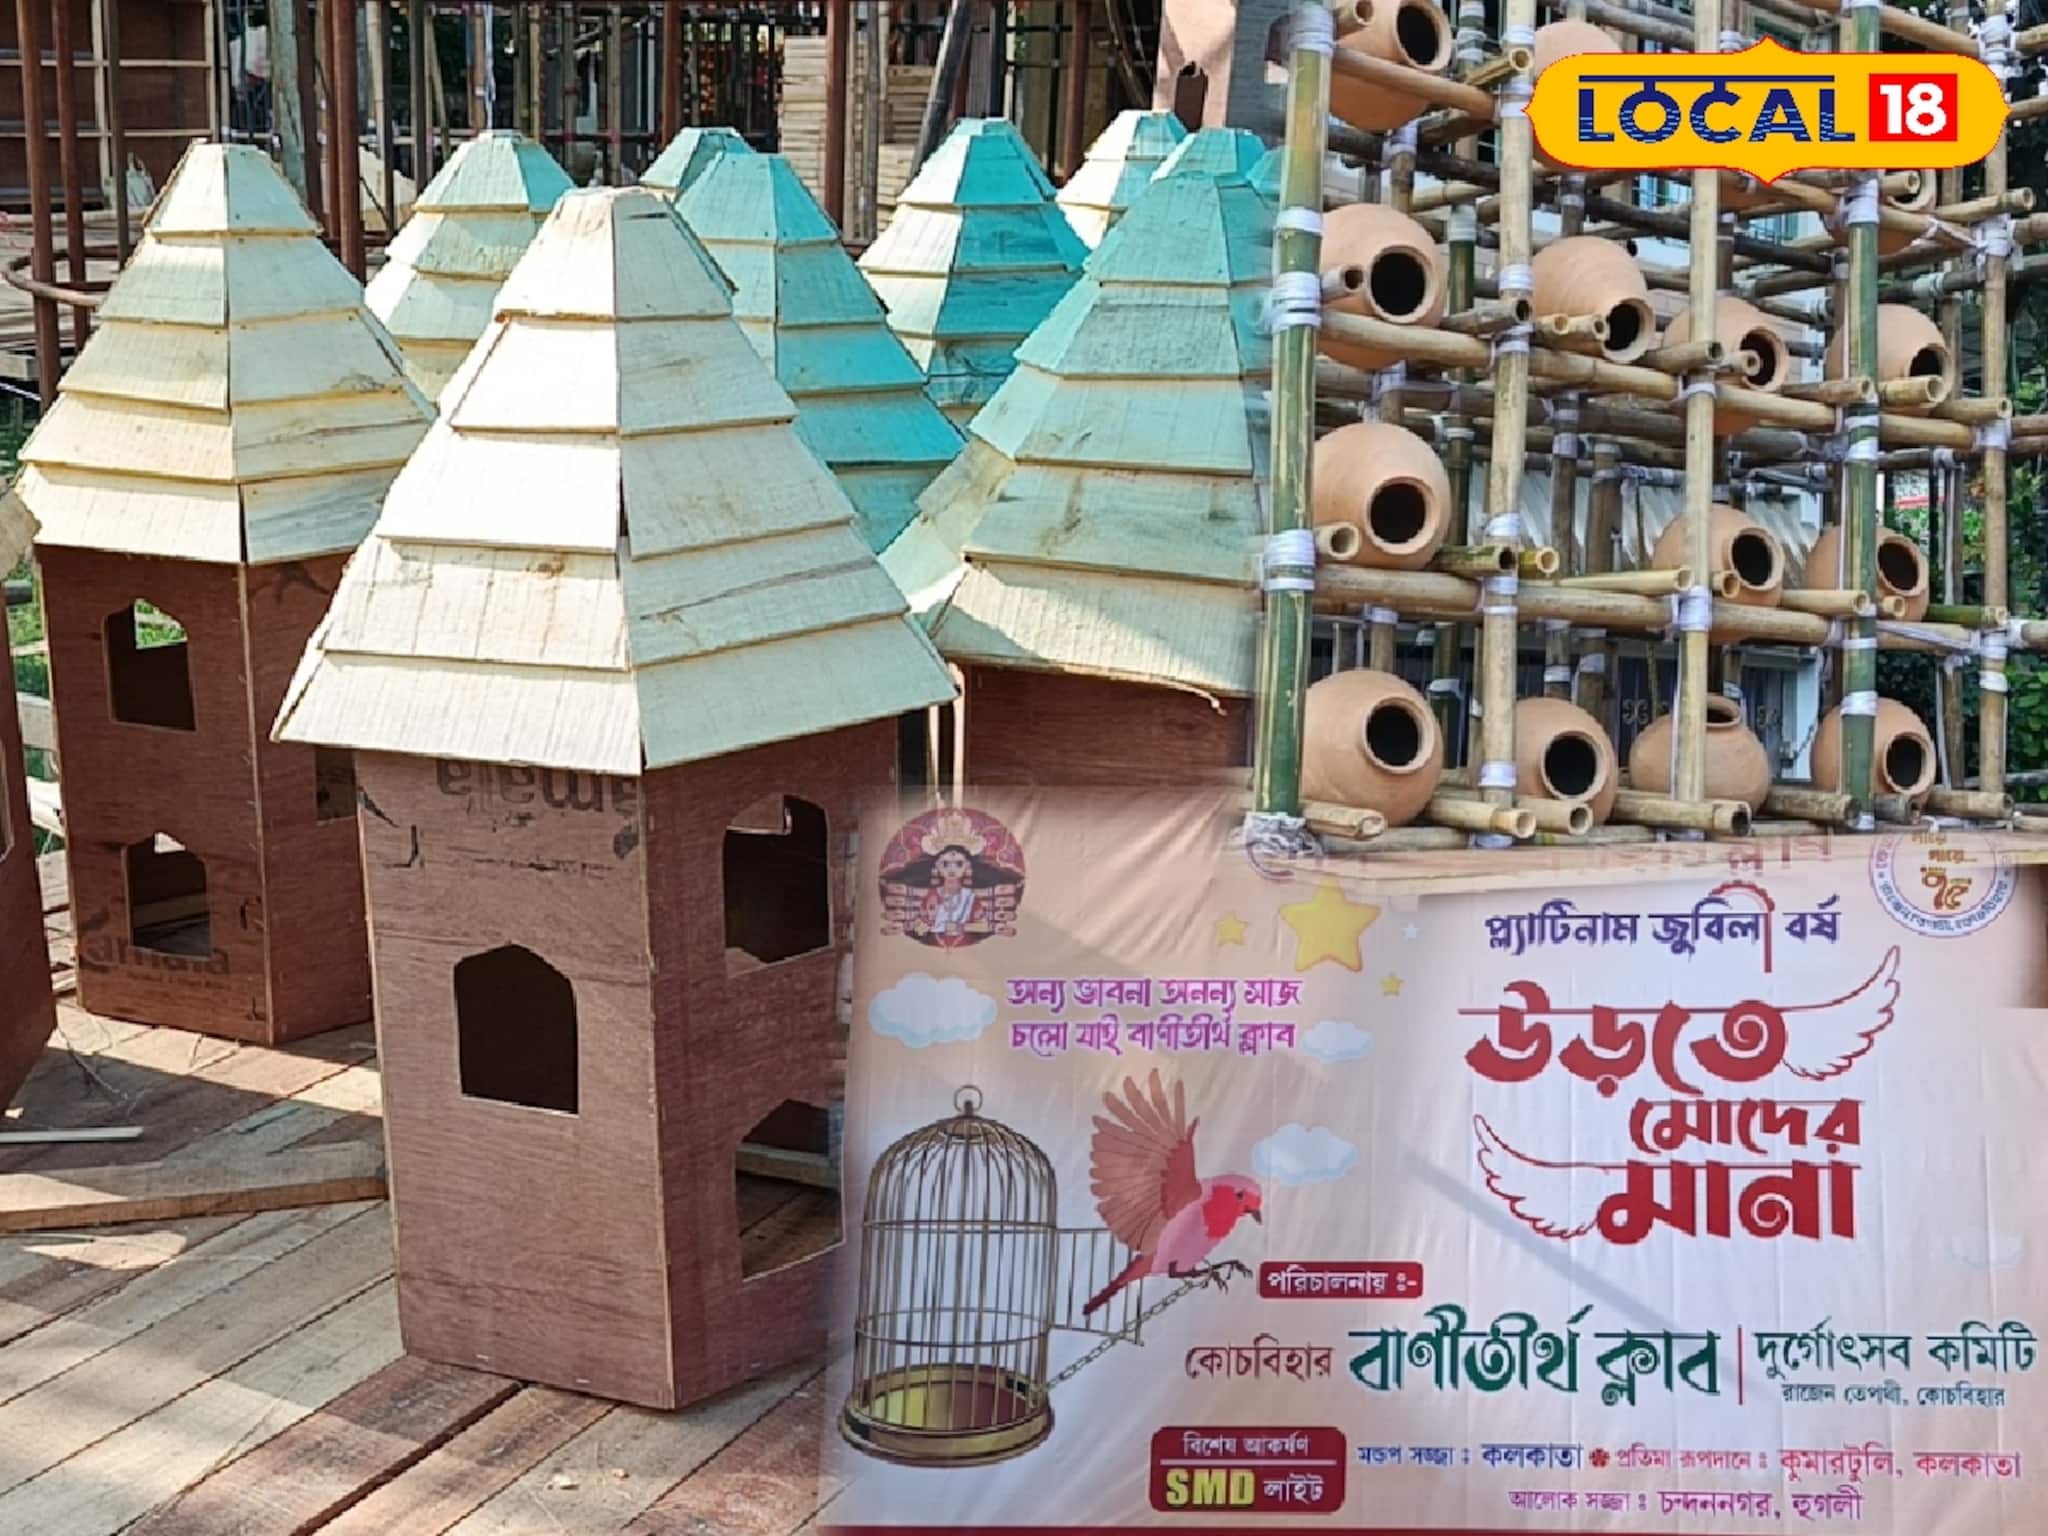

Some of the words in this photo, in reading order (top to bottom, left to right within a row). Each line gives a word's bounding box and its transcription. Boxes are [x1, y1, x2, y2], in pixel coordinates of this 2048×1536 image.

[1485, 897, 1641, 956] প্ল্যাটিনাম
[1647, 880, 1775, 973] জুবিলী
[1782, 893, 1842, 943] বর্ষ
[1006, 979, 1067, 1013] অন্য
[1073, 978, 1152, 1008] ভাবনা
[1158, 978, 1238, 1014] অনন্য
[1011, 1021, 1068, 1057] চলো
[1075, 1013, 1124, 1056] যাই
[1127, 1012, 1231, 1051] বাণীতীর্থ
[1238, 1022, 1296, 1056] ক্লাব
[1459, 979, 1788, 1098] উড়তে
[1628, 1096, 1866, 1156] মোদের
[1596, 1158, 1863, 1245] মানা
[1266, 1263, 1389, 1295] পরিচালনায়
[1184, 1332, 1334, 1383] কোচবিহার
[1348, 1303, 1594, 1392] বাণীতীর্থ
[1594, 1328, 1722, 1407] ক্লাব
[1753, 1315, 1913, 1380] দুর্গোৎসব
[1926, 1320, 2039, 1373] কমিটি
[1916, 1380, 2006, 1407] কোচবিহার
[1182, 1430, 1237, 1456] বিশেষ
[1243, 1430, 1309, 1456] আকর্ষণ
[1408, 1445, 1457, 1467] সজ্জা
[1481, 1443, 1584, 1470] কলকাতা
[1615, 1441, 1671, 1470] প্রতিমা
[1912, 1451, 2022, 1478] কলকাতা
[1165, 1467, 1256, 1506] SMD
[1263, 1472, 1325, 1505] লাইট
[1508, 1490, 1579, 1512] আলোক
[1585, 1491, 1631, 1512] সজ্জা
[1656, 1490, 1782, 1519] চন্দননগর,
[1791, 1484, 1864, 1521] হুগলী
